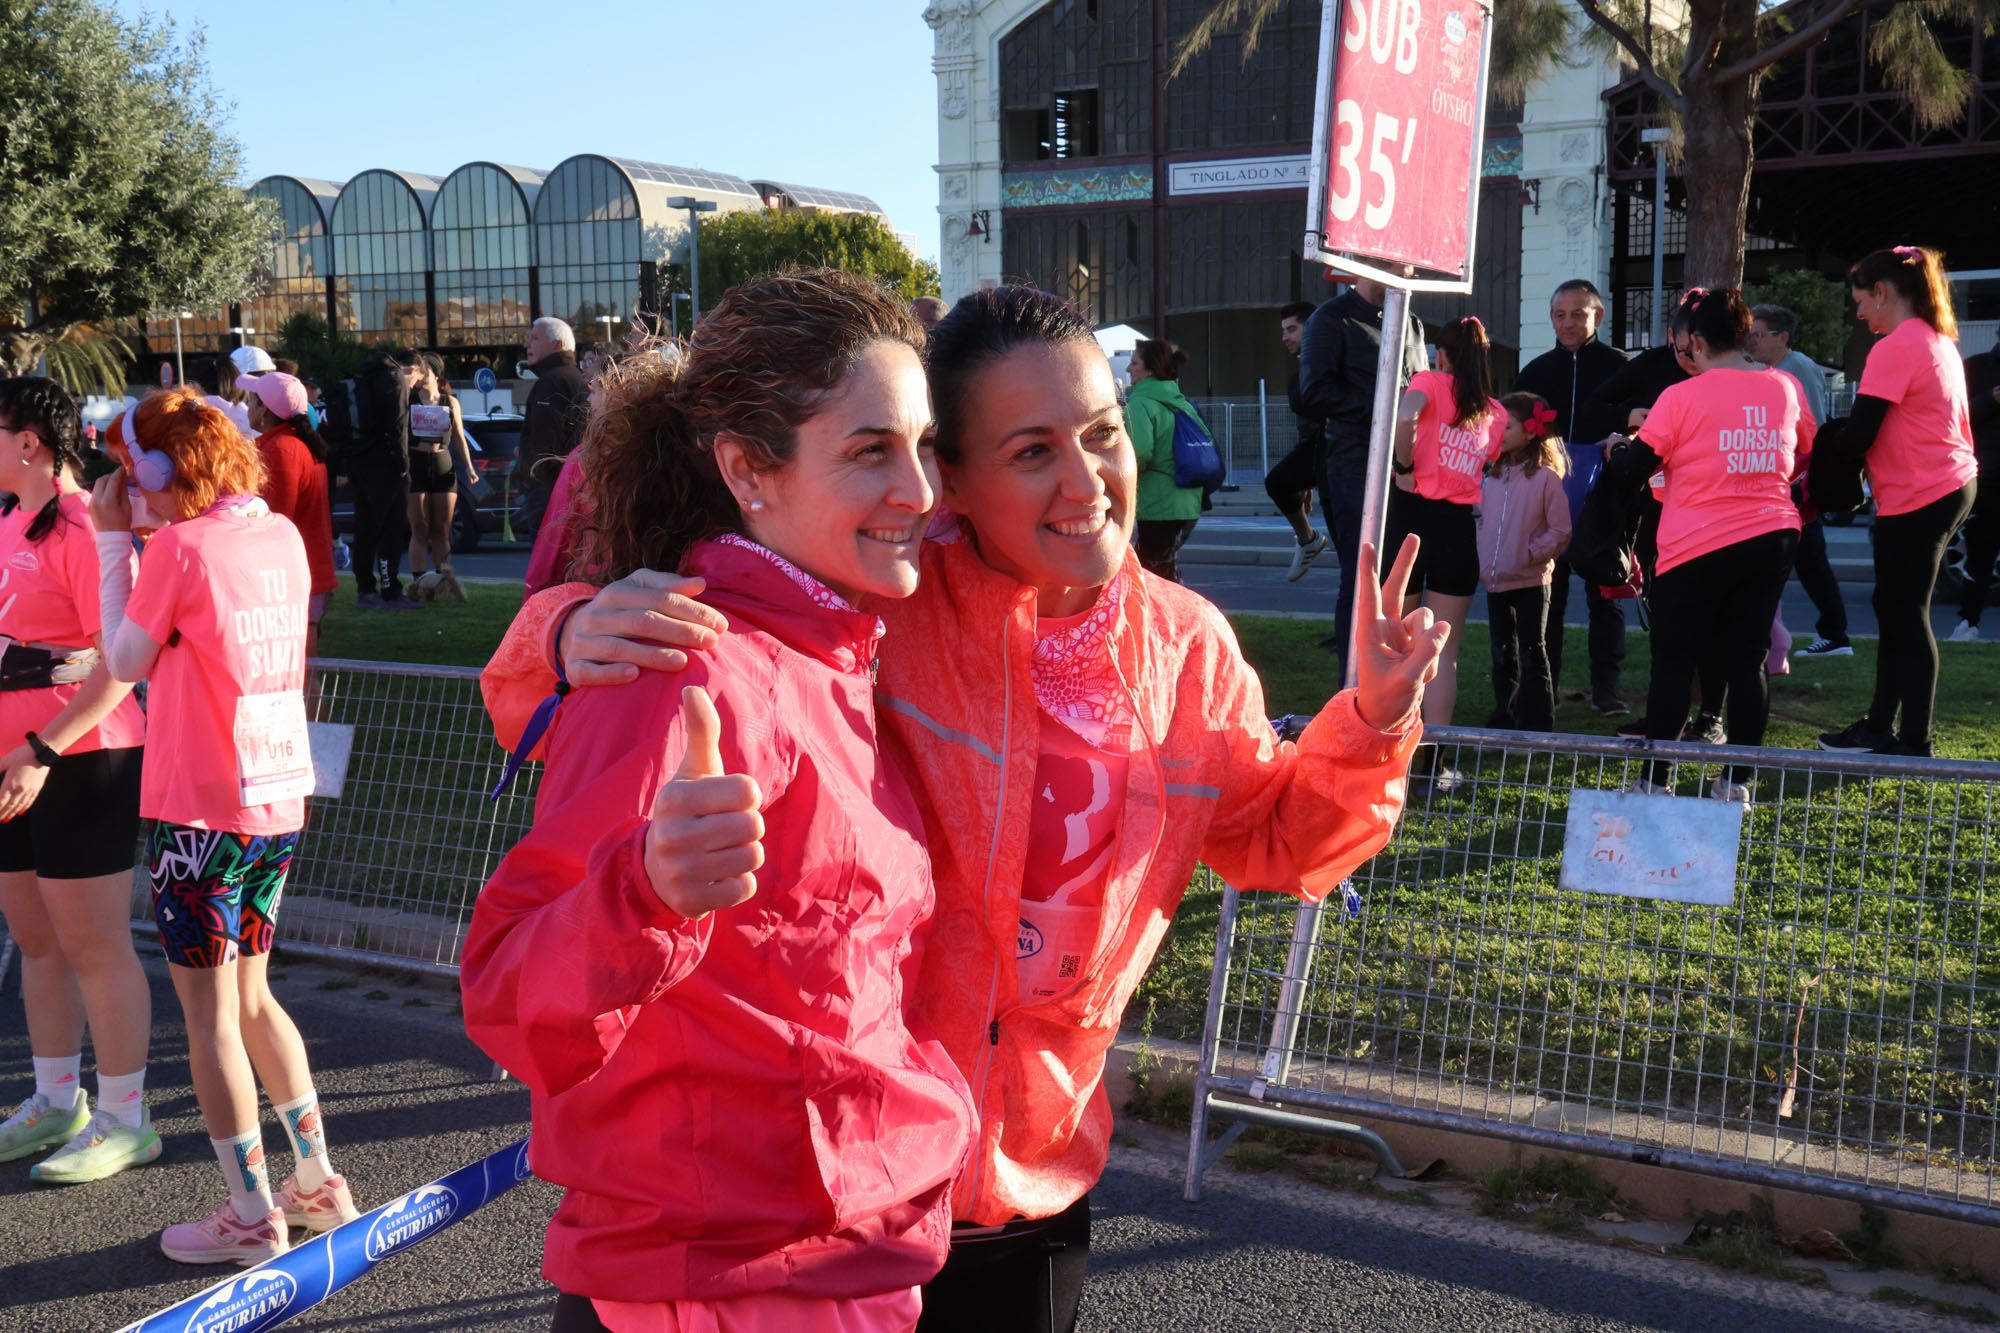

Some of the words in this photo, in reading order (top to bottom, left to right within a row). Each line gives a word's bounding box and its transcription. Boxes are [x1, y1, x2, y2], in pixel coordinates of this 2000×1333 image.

[1344, 0, 1421, 75] SUB
[1432, 88, 1473, 127] OYSHO
[1190, 168, 1269, 183] TINGLADO
[1297, 166, 1307, 177] 4
[1330, 98, 1418, 230] 35'
[1742, 406, 1767, 428] TU
[1727, 452, 1777, 474] SUMA
[259, 568, 287, 603] TU
[372, 1202, 450, 1256] ASTURIANA
[386, 1209, 417, 1230] CENTRAL
[418, 1194, 449, 1214] LECHERA
[207, 1299, 246, 1323] CENTRAL
[247, 1279, 285, 1303] LECHERA
